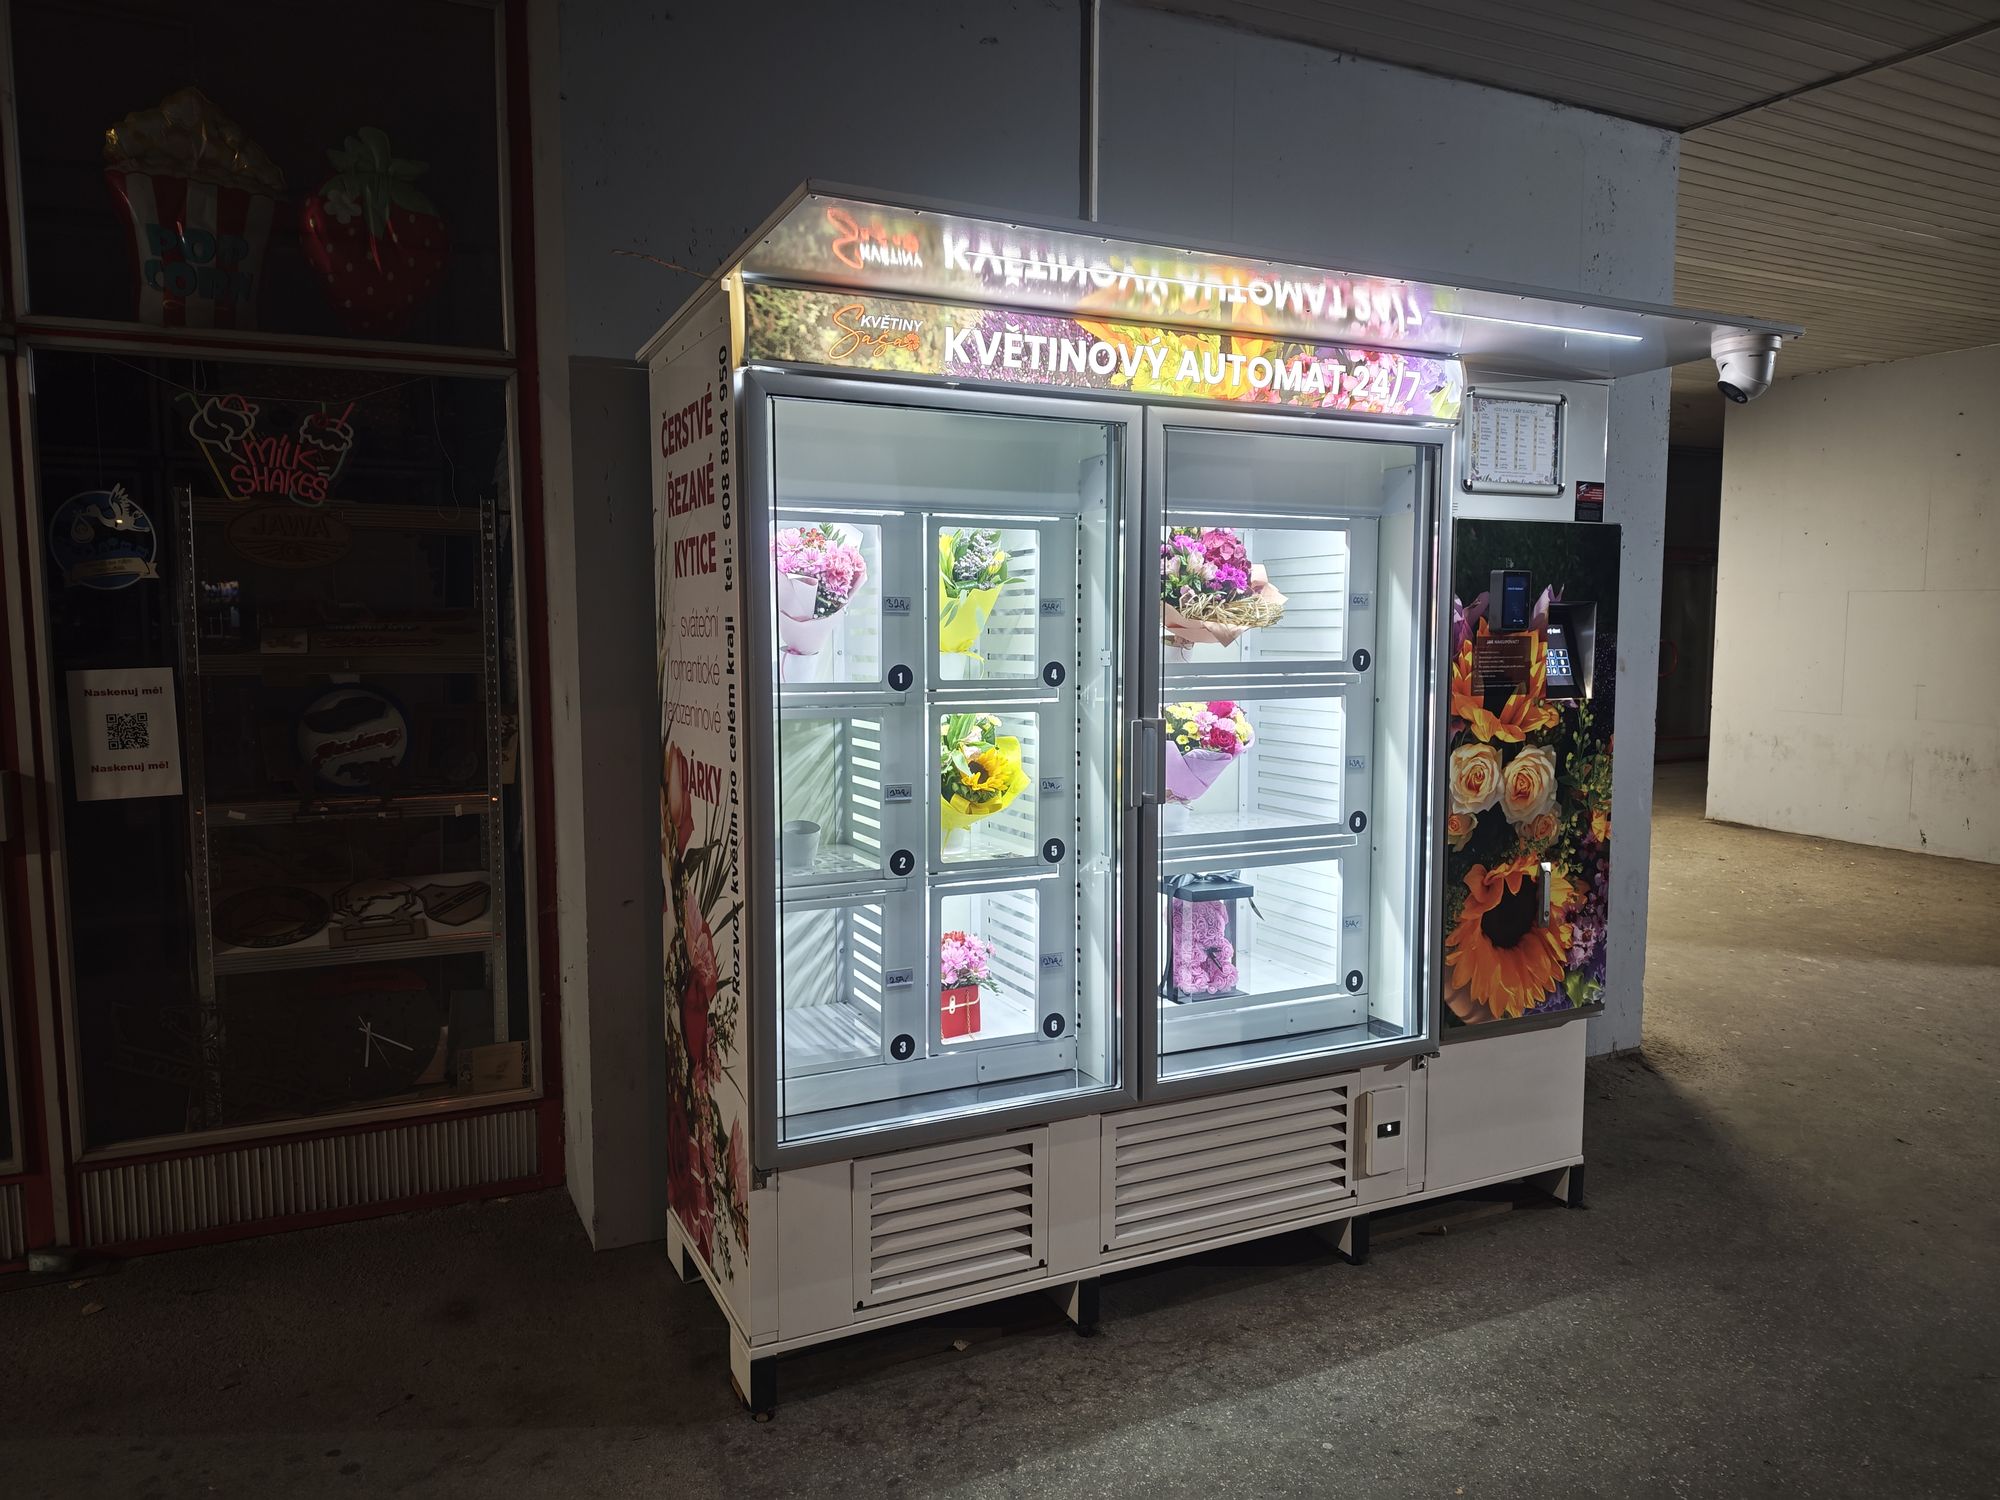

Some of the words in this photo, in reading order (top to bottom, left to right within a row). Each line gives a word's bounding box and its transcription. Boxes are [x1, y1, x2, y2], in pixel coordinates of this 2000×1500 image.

[860, 314, 924, 332] KVĚTINY
[718, 345, 728, 401] 950
[944, 323, 1169, 380] KVĚTINOVÝ
[1175, 350, 1347, 395] AUTOMAT
[1352, 359, 1421, 408] 24/7
[661, 382, 713, 458] ČERSTVÉ
[720, 408, 729, 465] 884
[667, 453, 715, 518] ŘEZANÉ
[722, 473, 731, 529] 608
[250, 512, 331, 538] JAWA
[674, 531, 717, 579] KYTICE
[680, 605, 719, 638] sváteční
[725, 616, 735, 675] kraji
[670, 654, 720, 686] romantické
[897, 672, 903, 684] 1
[1051, 669, 1057, 680] 4
[83, 688, 138, 697] Naskenuj
[728, 684, 737, 763] celém
[91, 762, 145, 773] Naskenuj
[681, 748, 722, 807] DÁRKY
[730, 770, 738, 805] po
[1355, 816, 1361, 827] 8
[899, 857, 906, 869] 2
[1050, 845, 1057, 857] 5
[1352, 975, 1358, 987] 9
[1050, 1019, 1057, 1031] 6
[899, 1041, 906, 1053] 3
